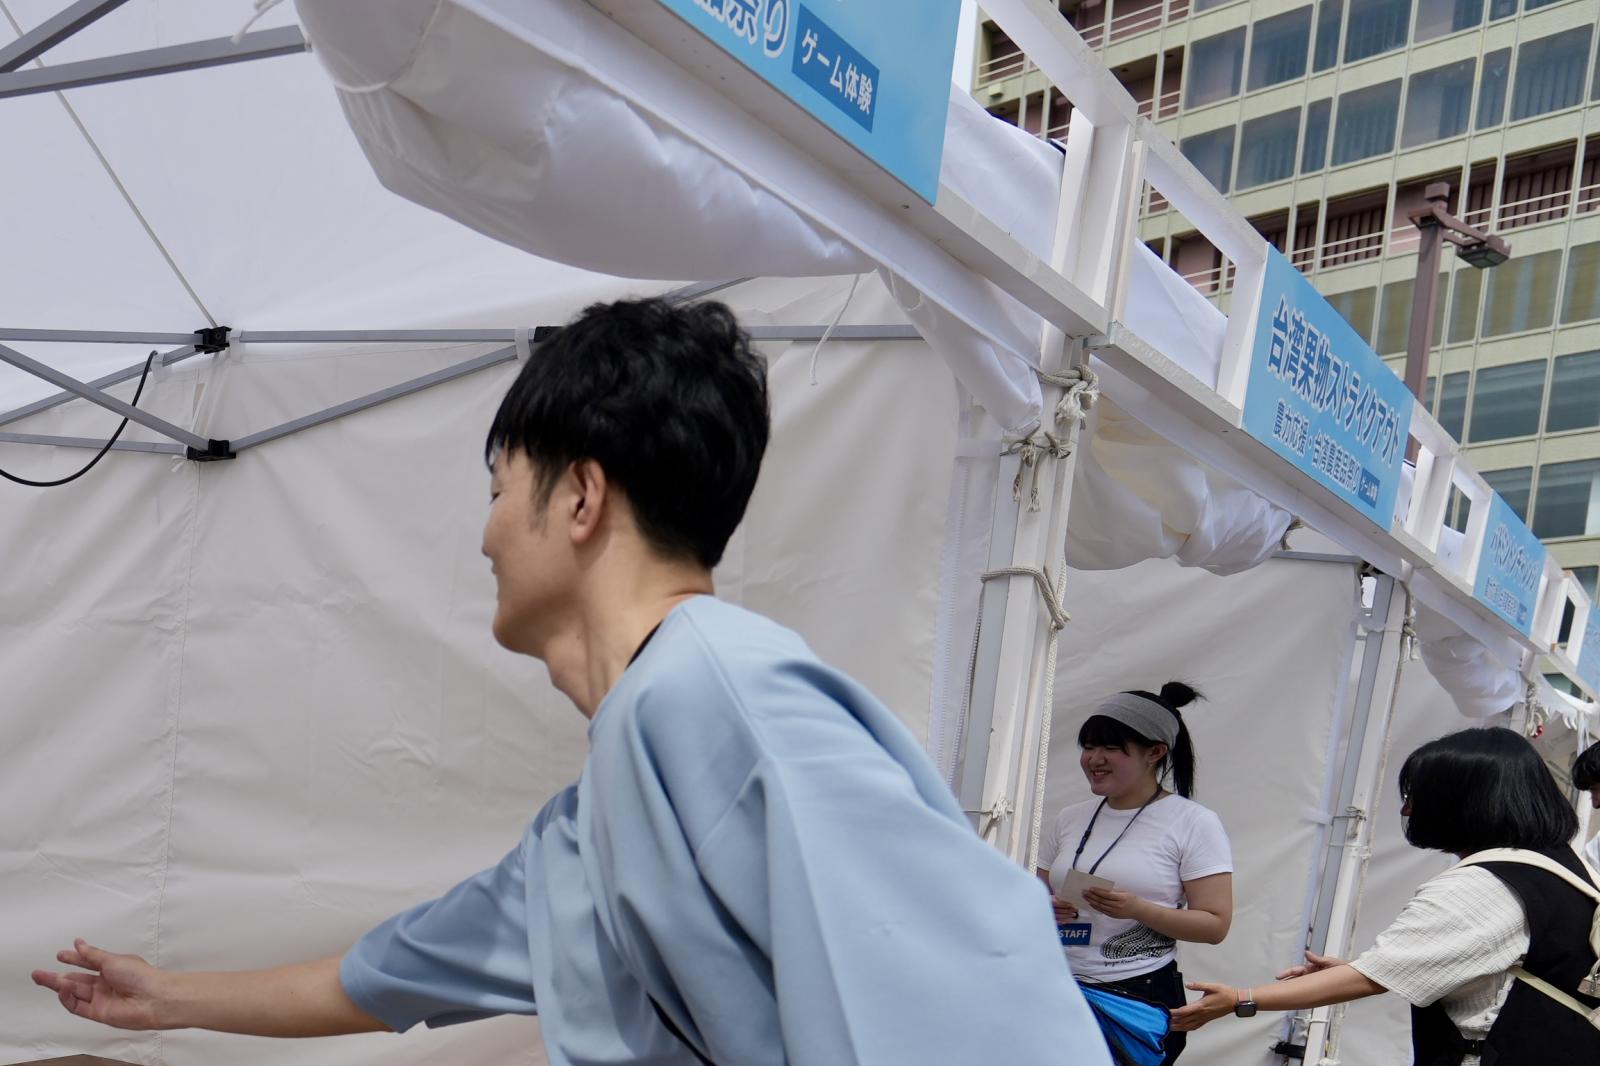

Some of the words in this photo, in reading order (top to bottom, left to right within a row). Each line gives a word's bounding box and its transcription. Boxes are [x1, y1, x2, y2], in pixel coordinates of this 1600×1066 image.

[801, 28, 873, 114] ゲーム体験
[1267, 294, 1400, 470] 台湾果物ストライクアウト
[1058, 929, 1088, 939] STAFF
